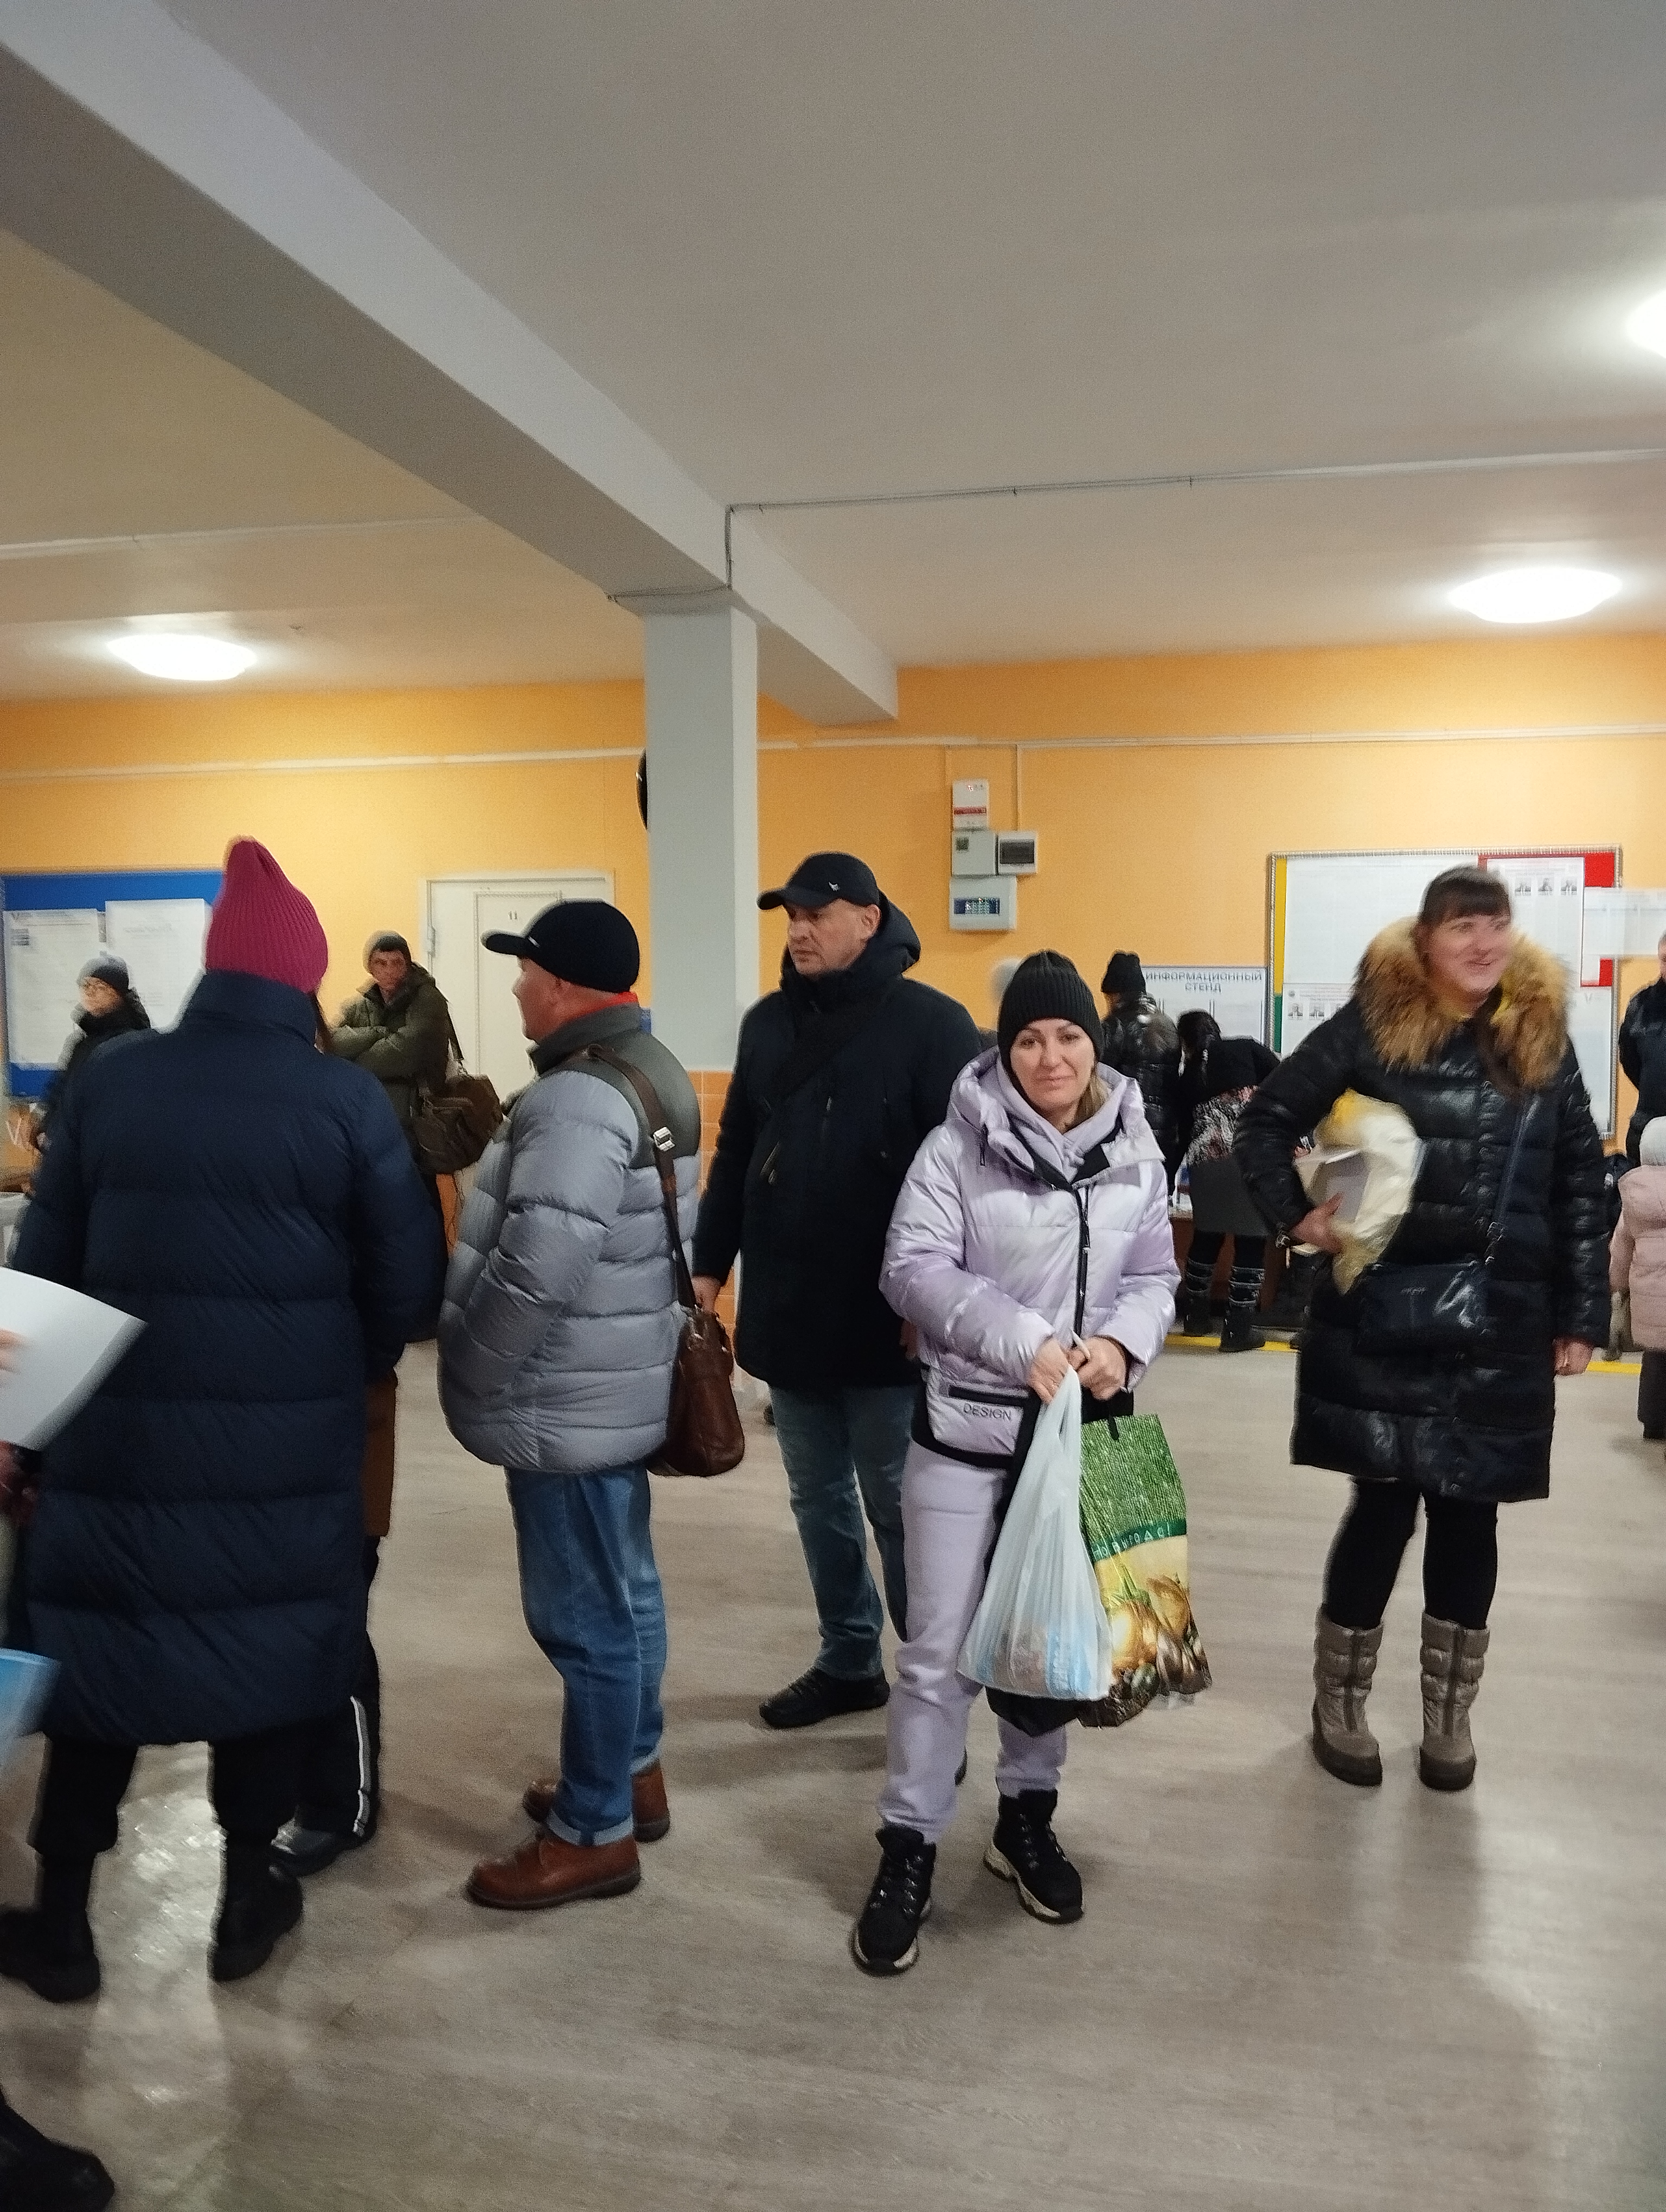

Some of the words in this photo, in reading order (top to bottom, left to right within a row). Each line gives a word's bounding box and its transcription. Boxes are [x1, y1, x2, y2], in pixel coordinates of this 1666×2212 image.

[1145, 970, 1263, 982] ИНФОРМАЦИОННЫЙ
[1185, 982, 1221, 993] СТЕНД
[963, 1403, 1012, 1421] DESIGN
